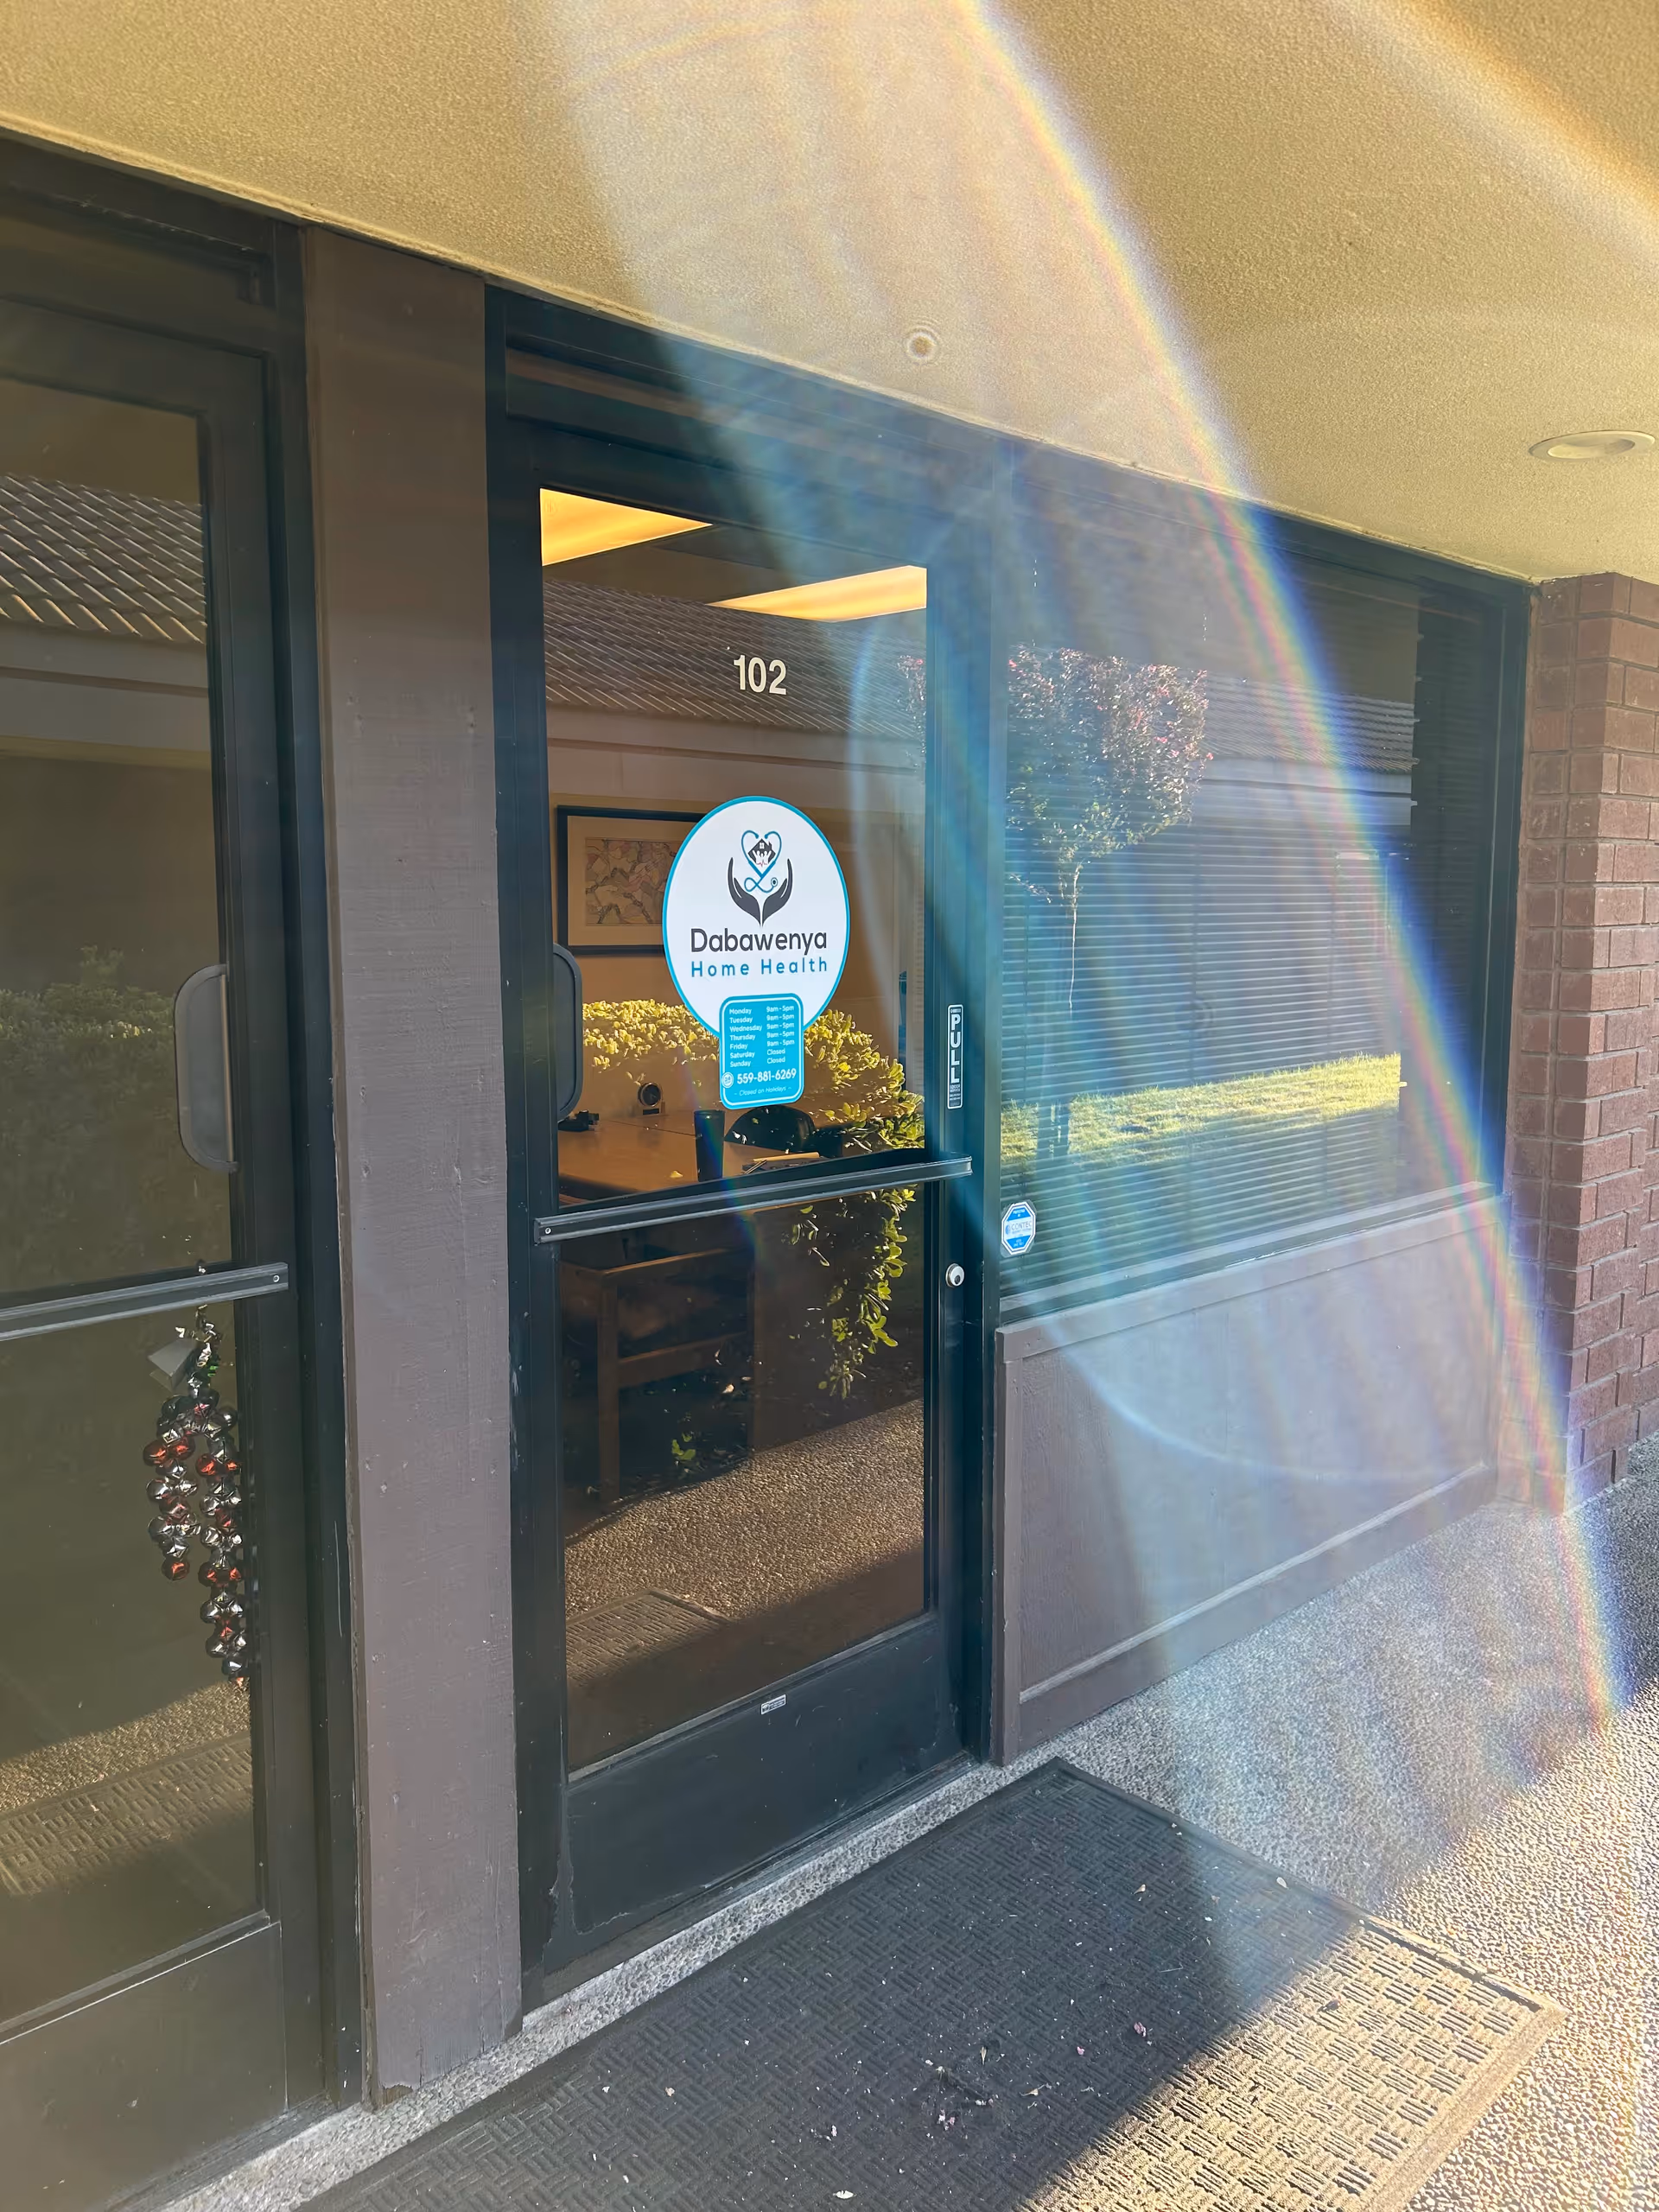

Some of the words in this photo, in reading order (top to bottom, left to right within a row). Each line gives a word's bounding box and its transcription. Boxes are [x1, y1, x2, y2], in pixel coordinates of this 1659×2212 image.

[734, 655, 786, 695] 102
[690, 928, 827, 956] Dabawenya
[691, 961, 749, 977] Home
[761, 957, 827, 975] Health
[950, 1014, 961, 1084] PULL
[737, 1068, 797, 1084] 559-881-6269
